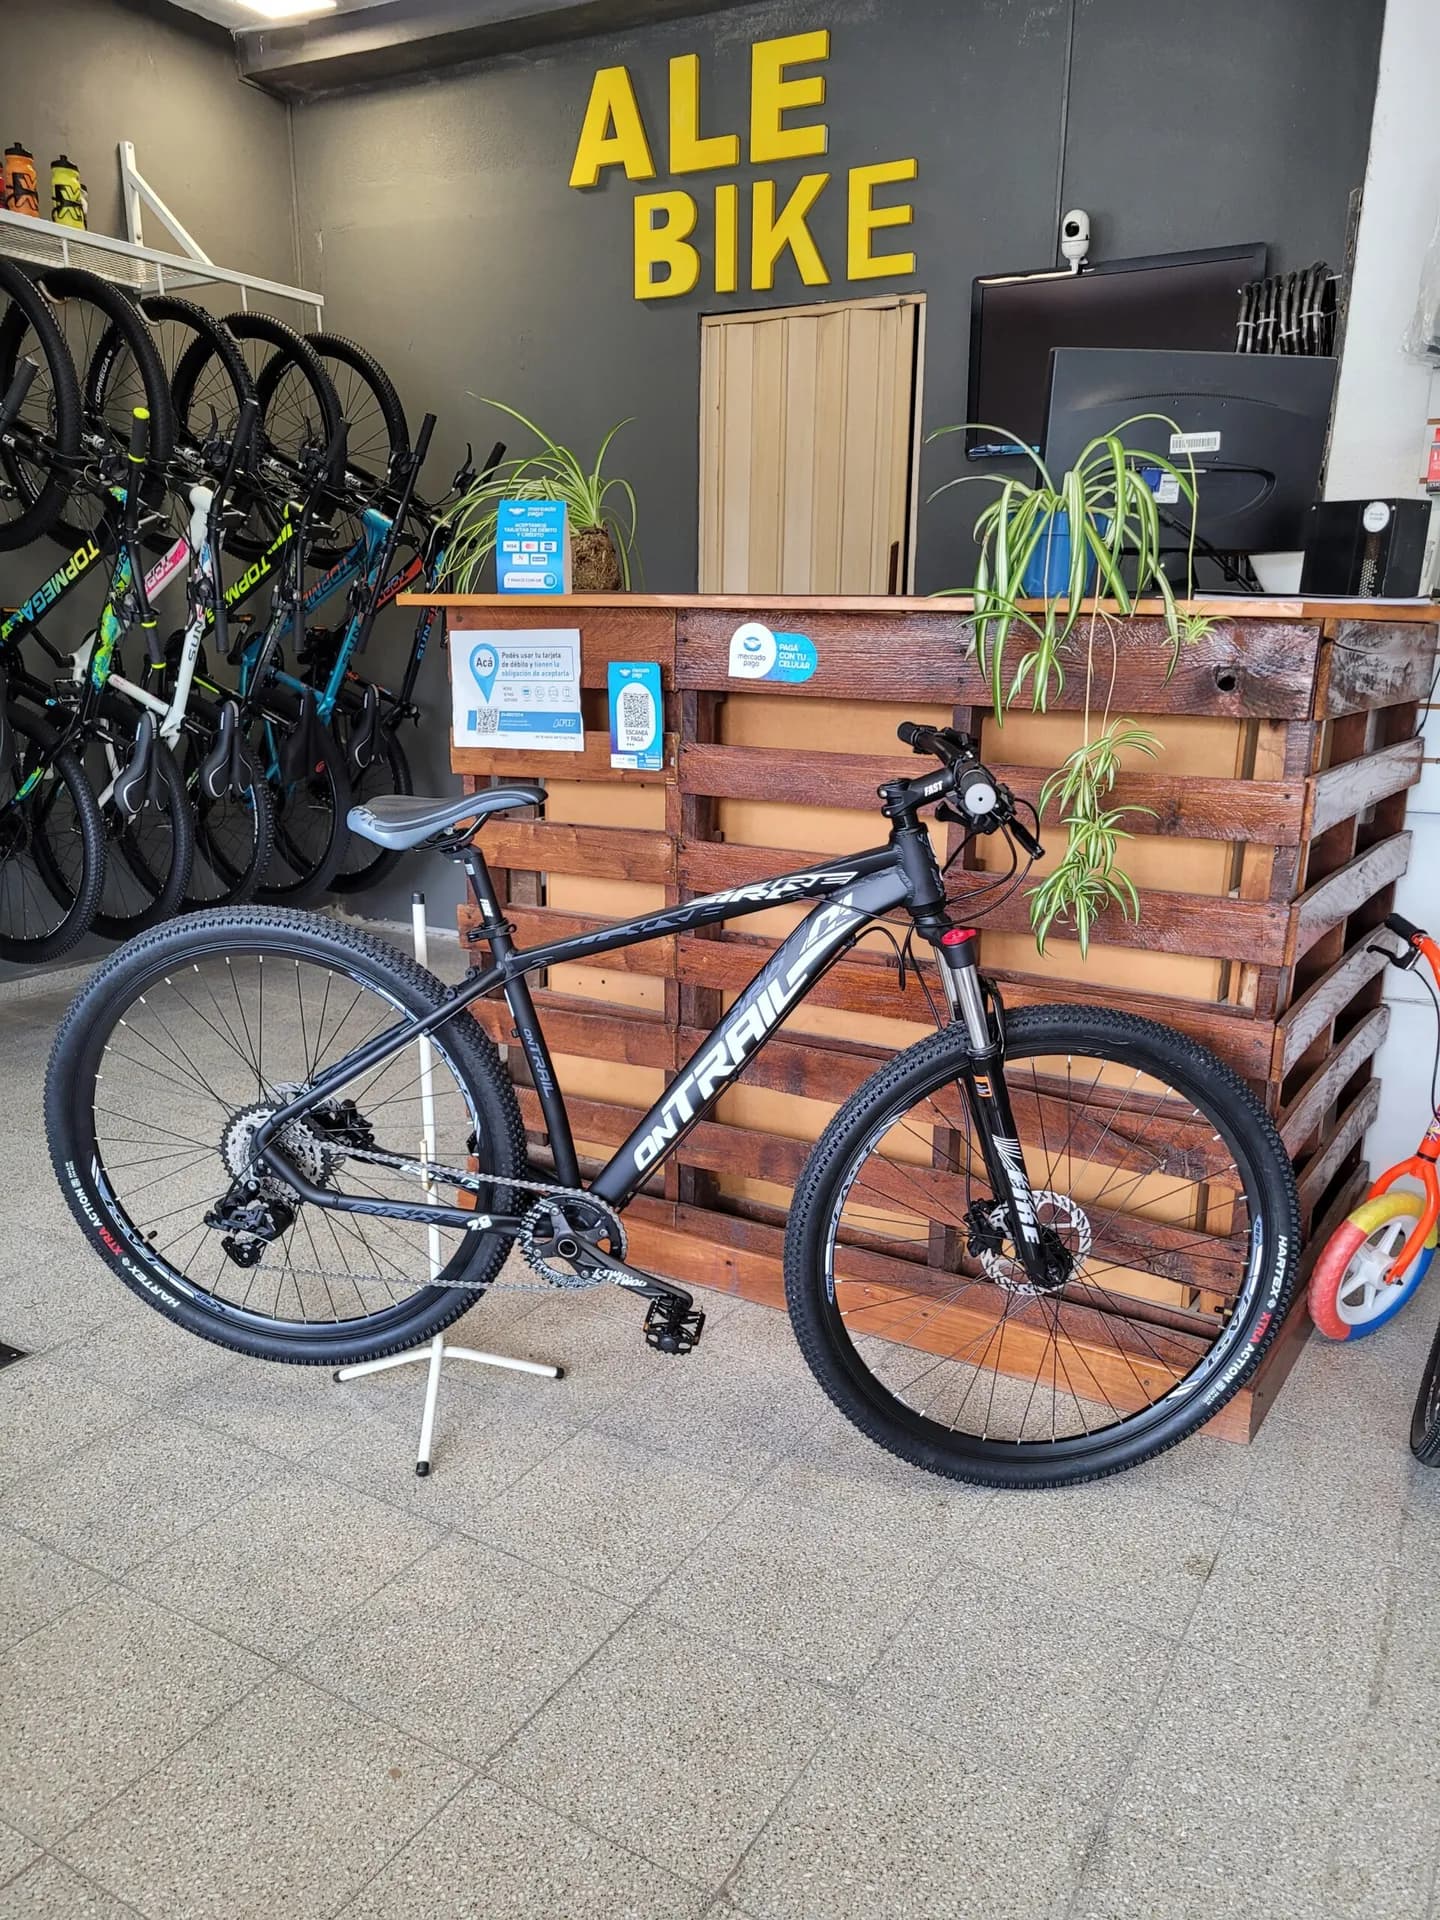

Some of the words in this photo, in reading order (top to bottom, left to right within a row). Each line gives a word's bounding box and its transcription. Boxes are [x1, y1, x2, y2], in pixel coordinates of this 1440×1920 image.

[569, 29, 830, 188] ALE
[634, 158, 918, 300] BIKE
[21, 539, 100, 622] TOPMEGA
[476, 657, 494, 668] Acá
[737, 653, 767, 661] mercado
[743, 660, 760, 668] pago
[778, 660, 811, 670] CELULAR
[779, 652, 795, 660] CON
[796, 653, 807, 661] TU
[924, 781, 944, 797] FAST
[523, 1027, 554, 1099] ONTRAIL
[633, 973, 808, 1171] ONTRAIL
[74, 1187, 103, 1227] ACTION
[98, 1226, 124, 1256] XTRA
[127, 1264, 181, 1308] HARTEX
[1269, 1234, 1288, 1299] HARTEX
[1249, 1311, 1272, 1343] XTRA
[1226, 1342, 1256, 1384] ACTION
